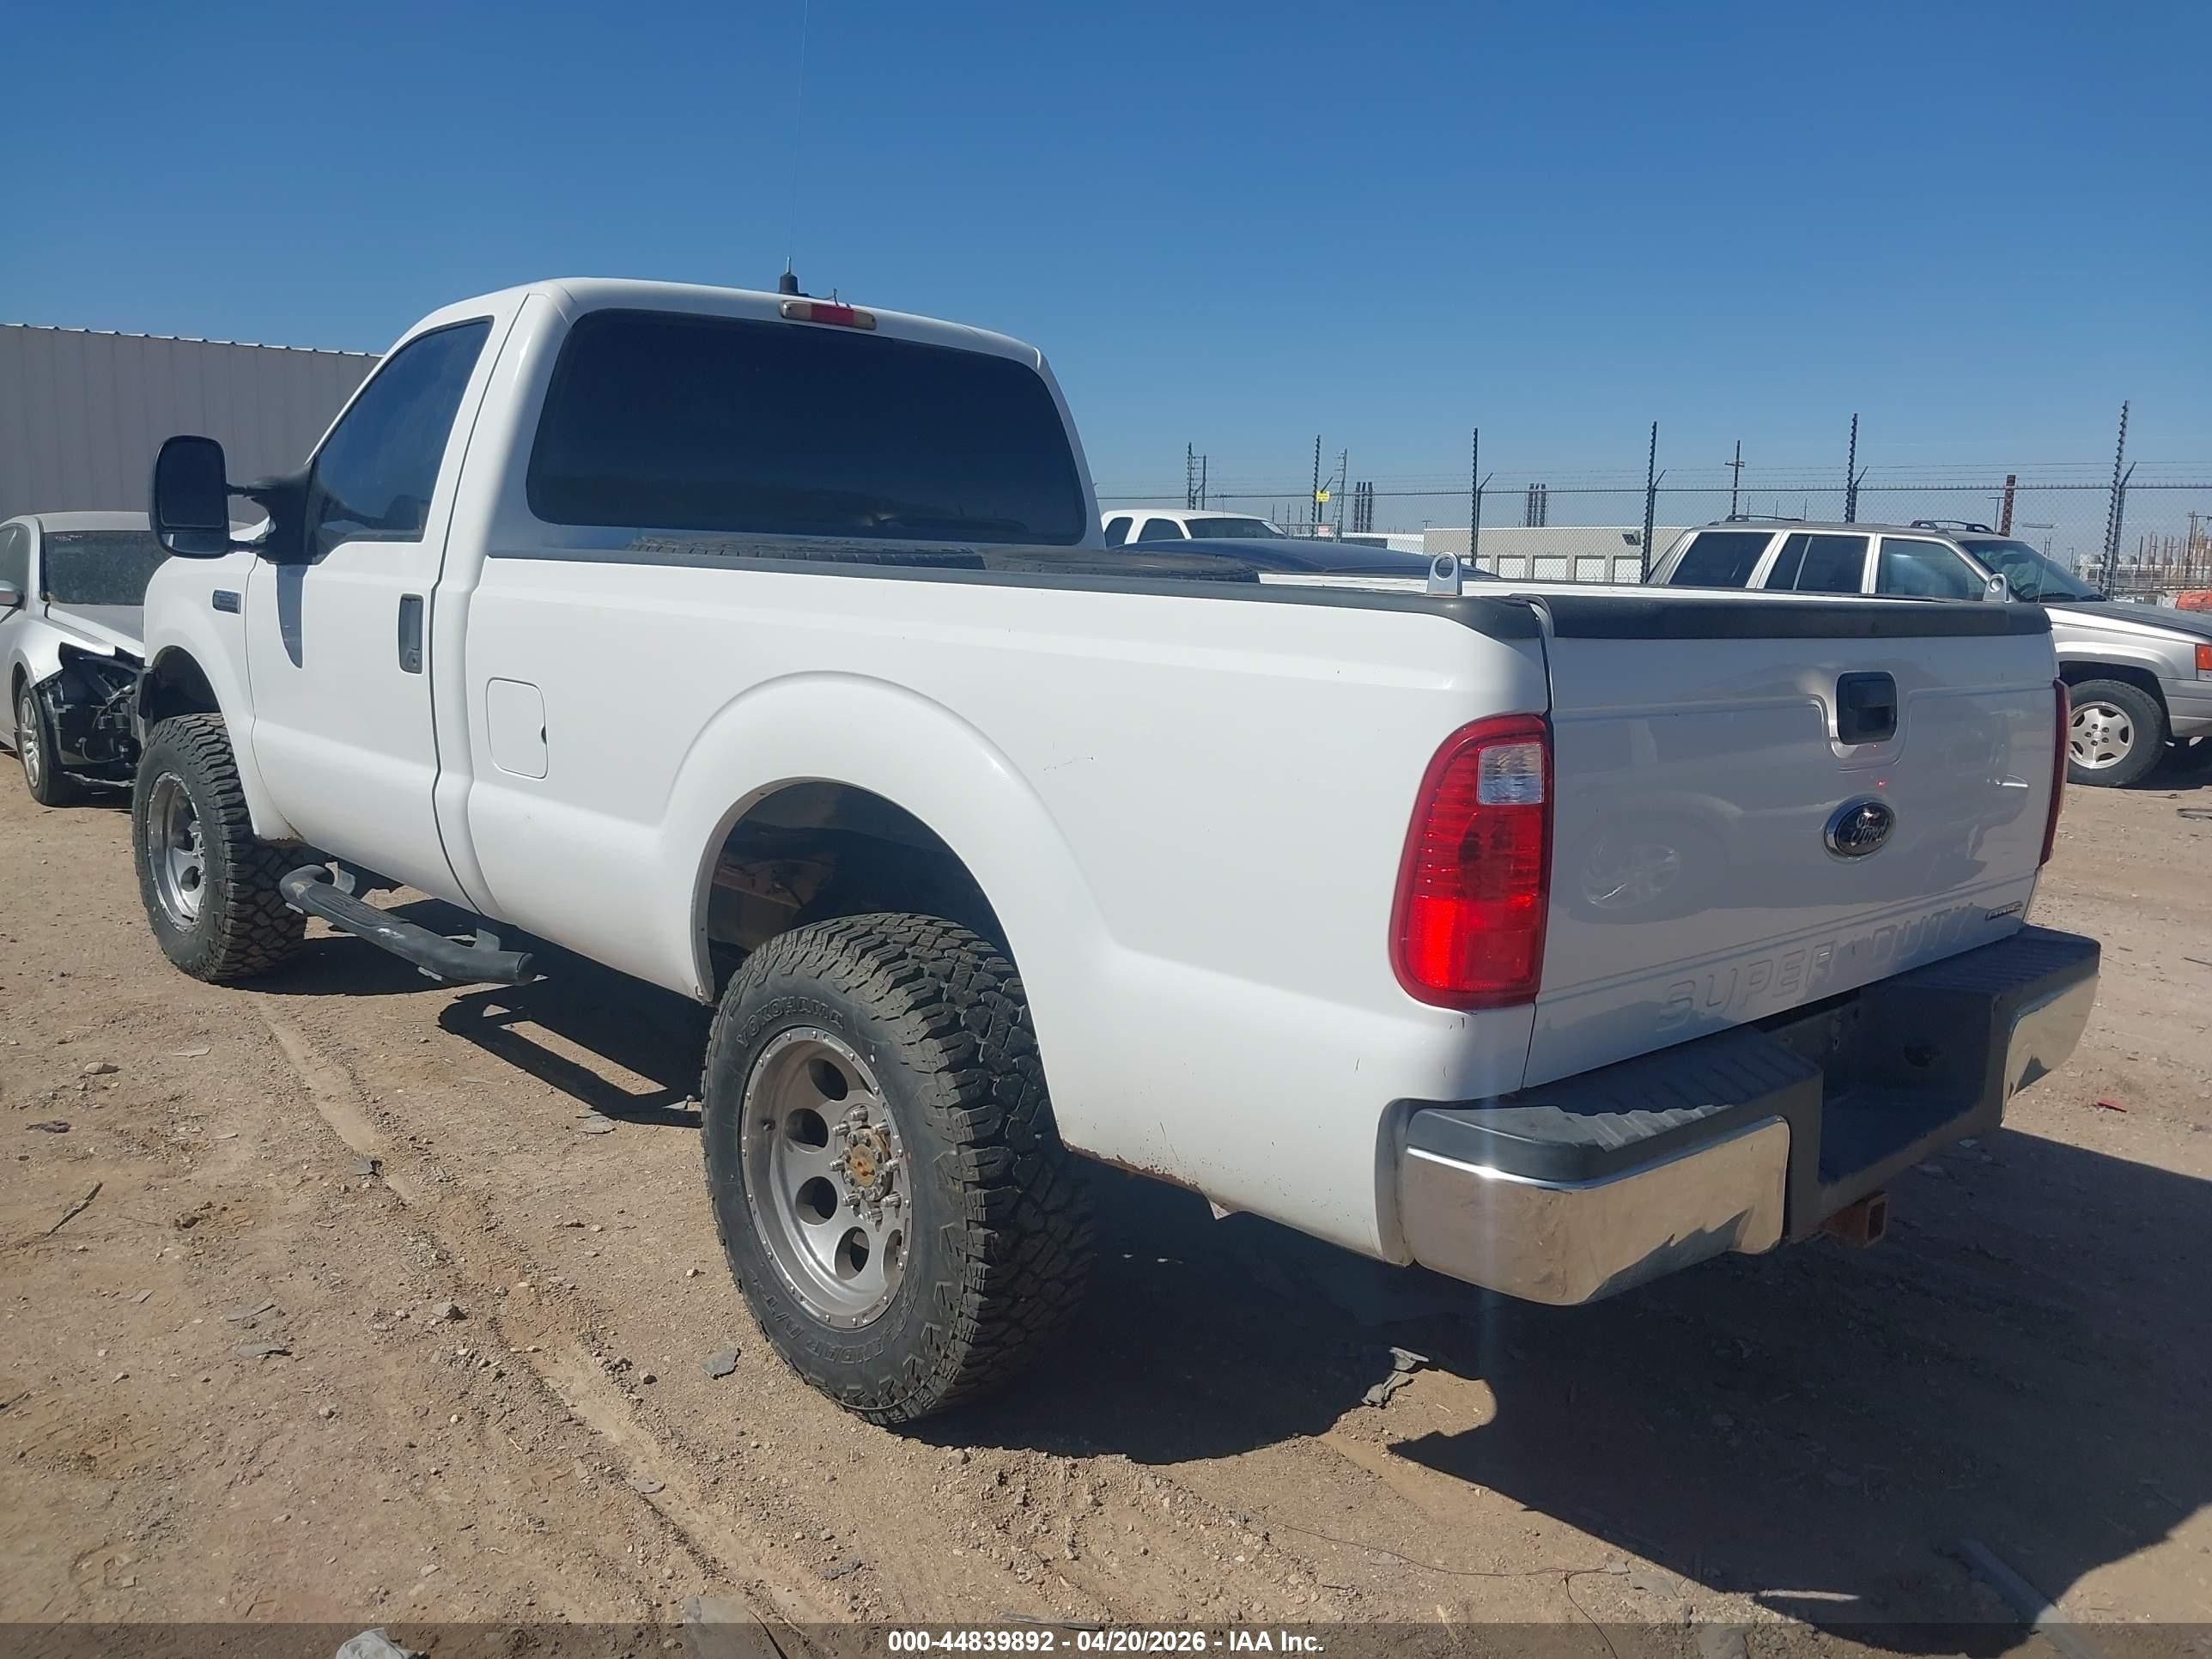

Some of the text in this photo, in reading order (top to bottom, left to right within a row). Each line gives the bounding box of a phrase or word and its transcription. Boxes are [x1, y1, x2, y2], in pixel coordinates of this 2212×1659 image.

[1656, 902, 1977, 1033] SUPER DUTY
[736, 996, 845, 1048] YOKOHAMA
